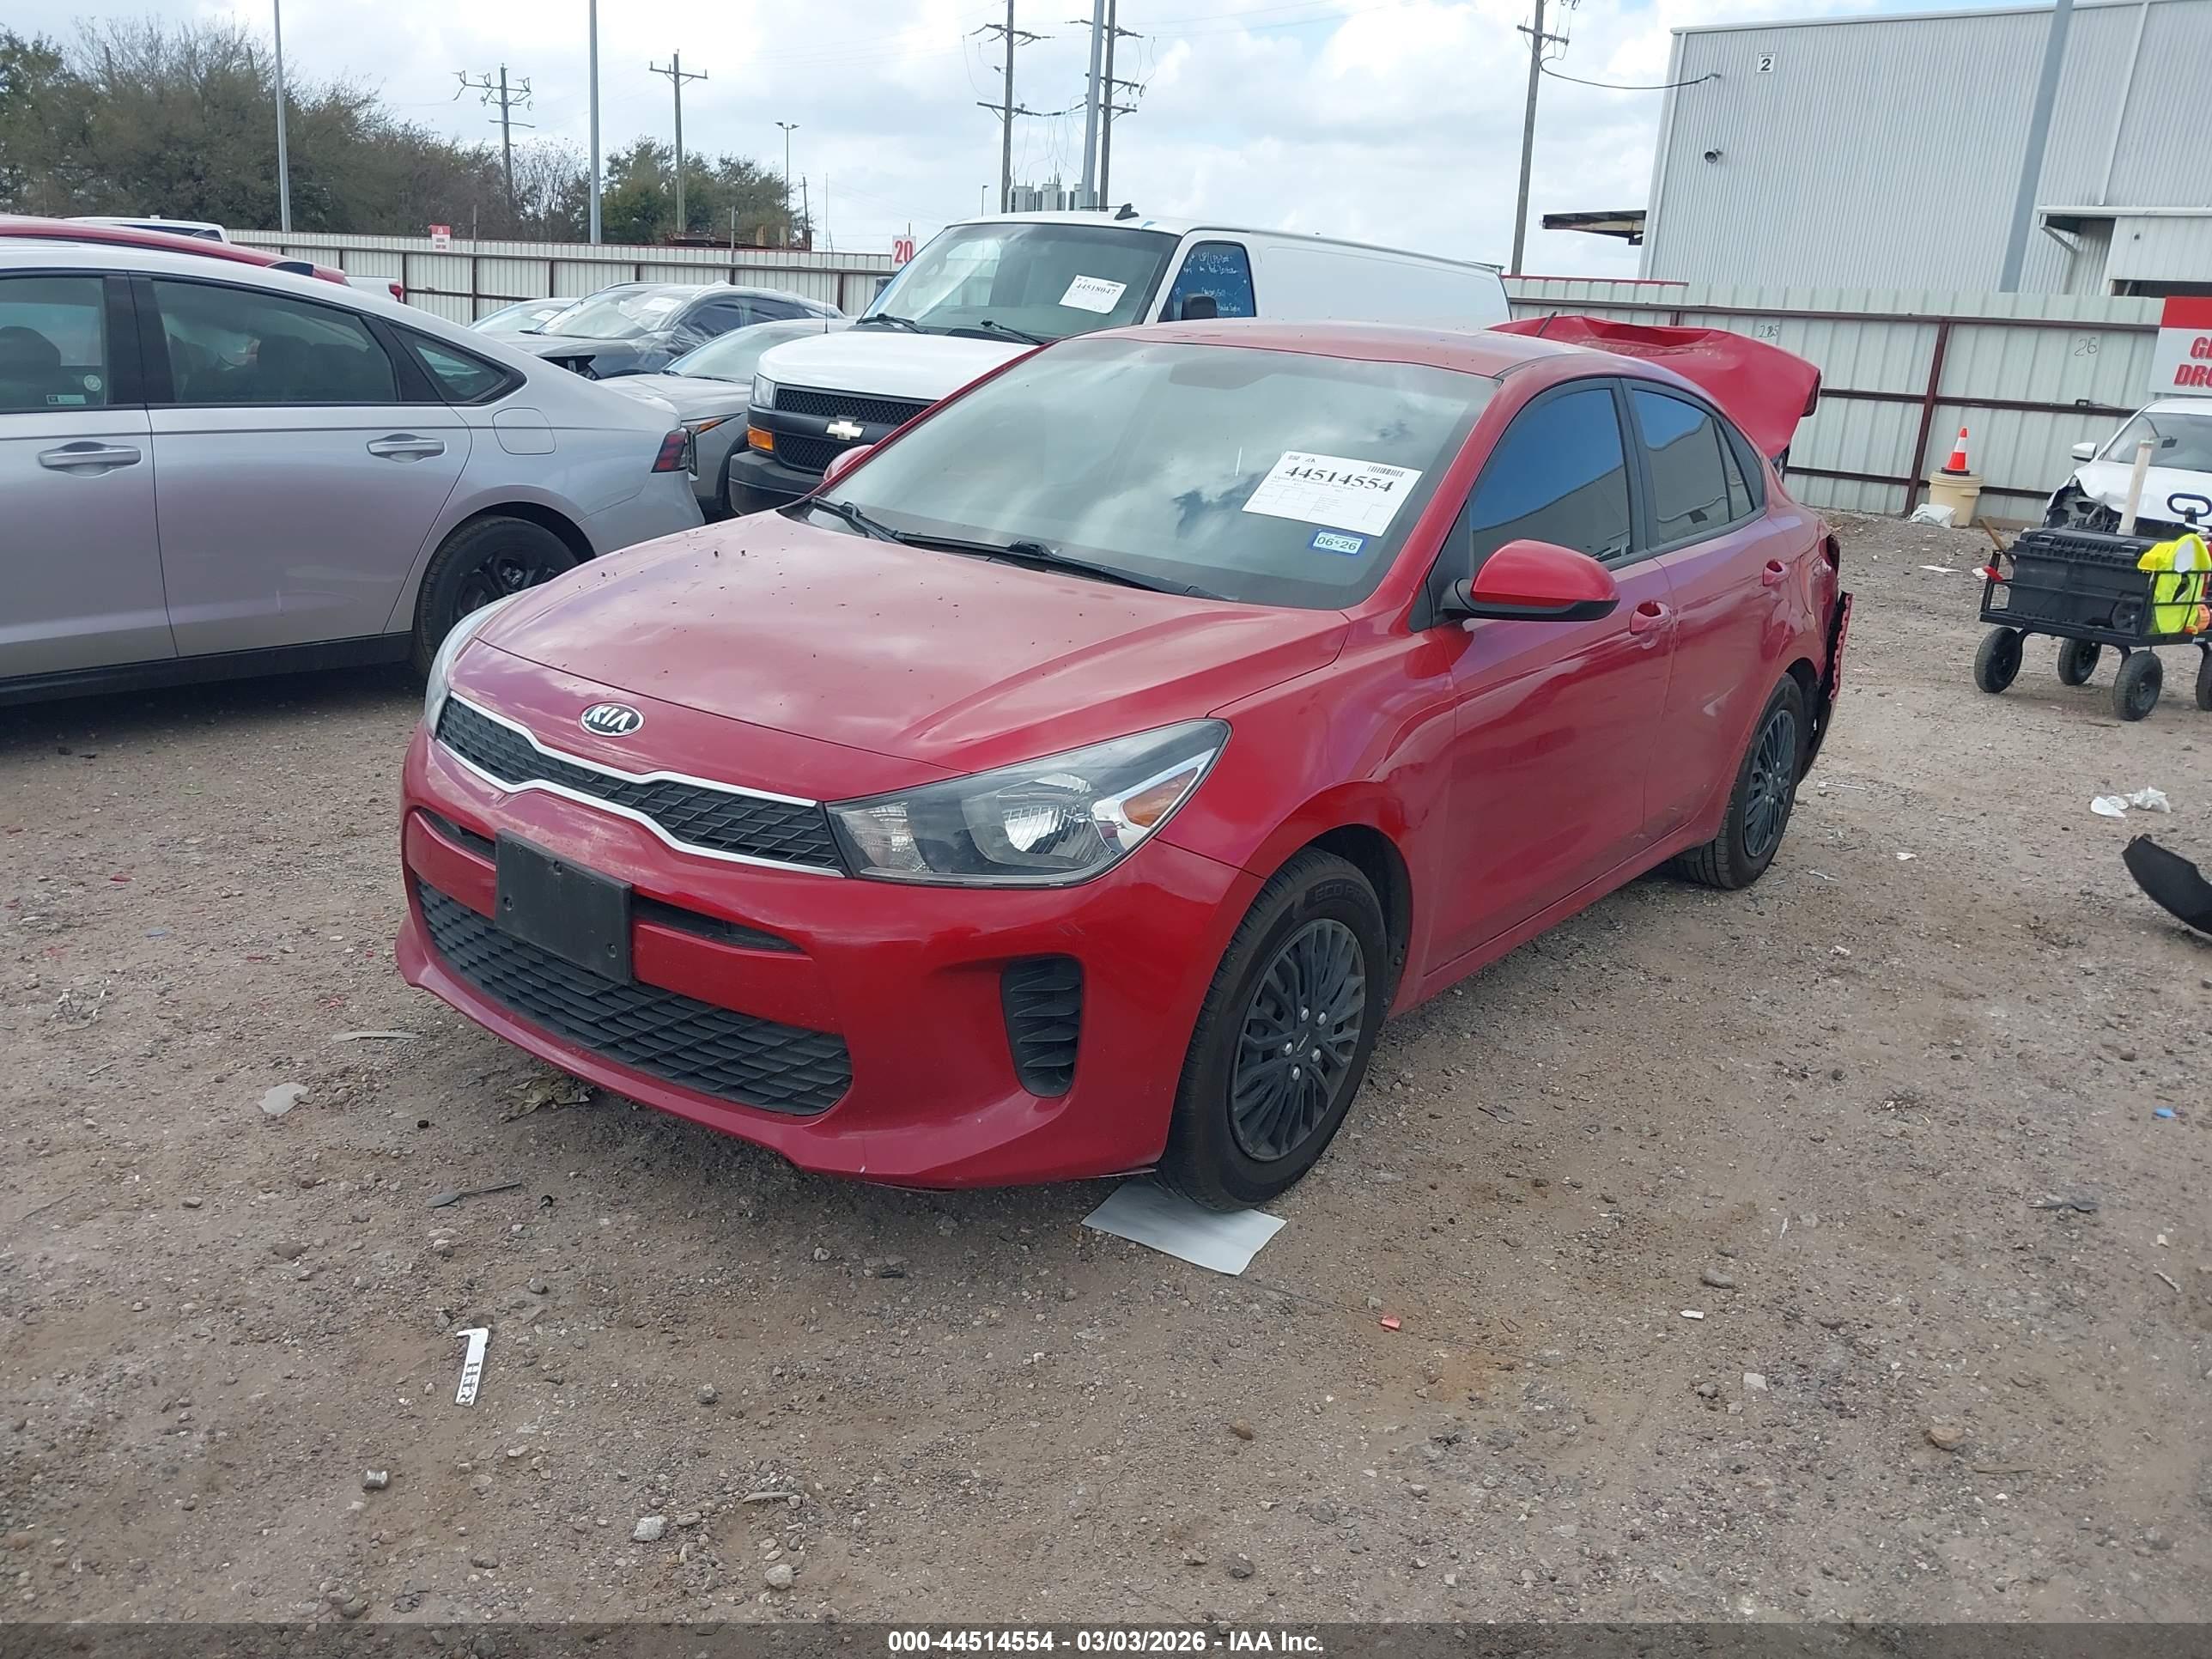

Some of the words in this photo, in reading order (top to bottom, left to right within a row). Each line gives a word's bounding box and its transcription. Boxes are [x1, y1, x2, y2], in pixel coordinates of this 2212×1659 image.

[1760, 58, 1771, 71] 2
[895, 240, 913, 264] 20
[2074, 337, 2097, 356] 26
[1285, 465, 1395, 493] 44514554
[586, 705, 633, 731] KIA
